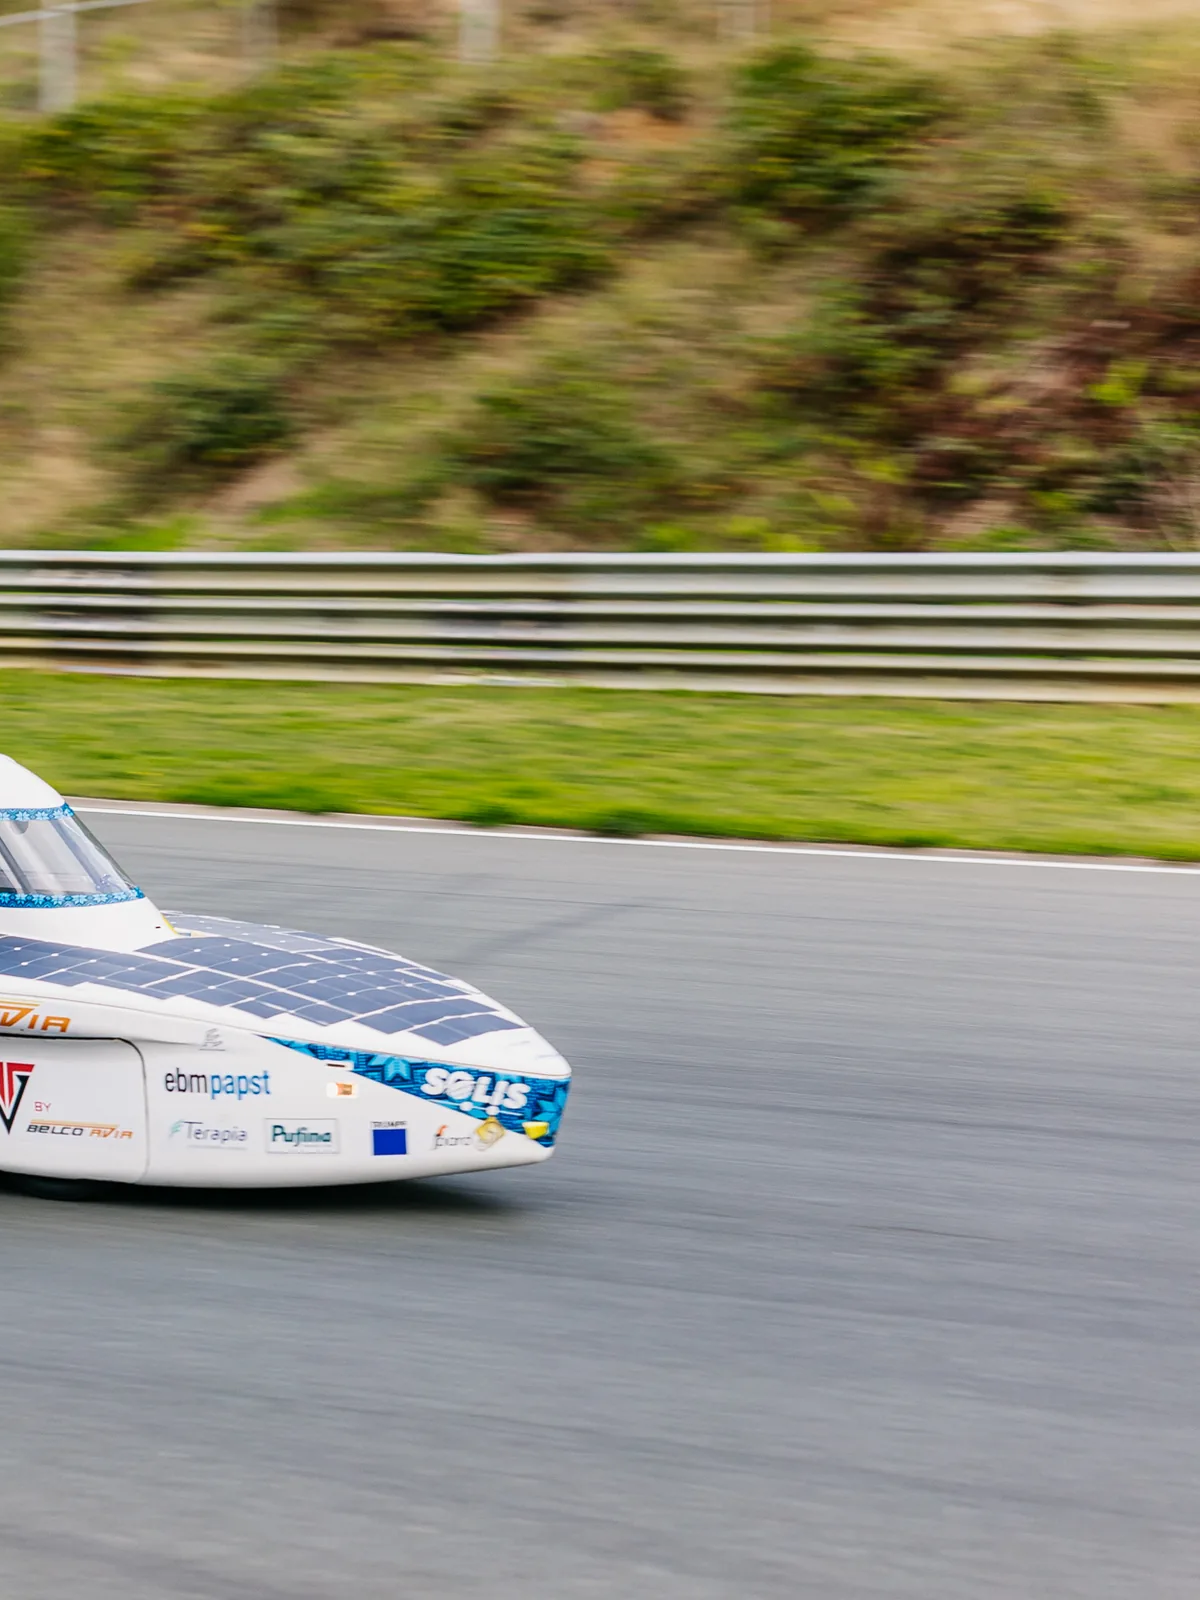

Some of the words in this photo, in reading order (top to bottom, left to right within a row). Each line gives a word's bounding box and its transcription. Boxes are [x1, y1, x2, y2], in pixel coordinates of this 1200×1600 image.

[165, 1067, 272, 1101] ebmpapst
[420, 1067, 531, 1109] SOLIS
[35, 1101, 51, 1112] BY
[184, 1121, 248, 1144] Terapia
